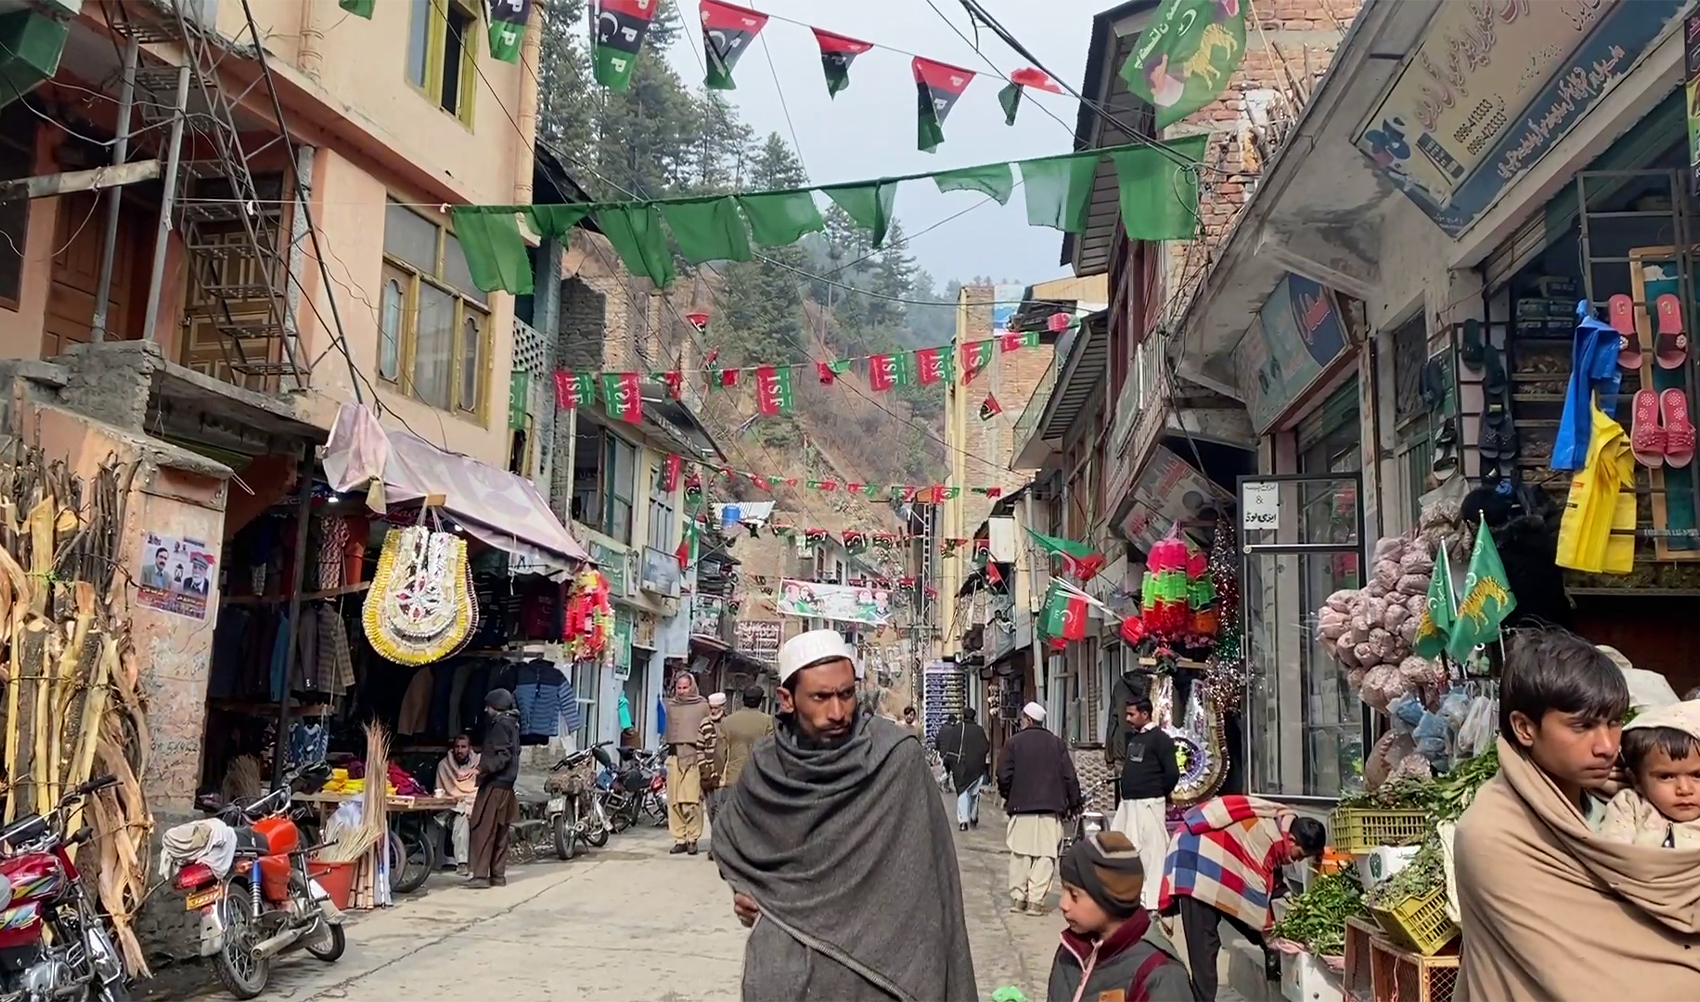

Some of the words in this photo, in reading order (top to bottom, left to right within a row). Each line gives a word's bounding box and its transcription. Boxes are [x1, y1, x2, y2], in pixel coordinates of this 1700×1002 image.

[502, 31, 516, 46] P
[621, 26, 638, 42] P
[611, 57, 627, 73] P
[1453, 98, 1494, 144] 0996-413333
[1467, 110, 1508, 157] 0996-423333
[882, 357, 898, 385] ISF
[929, 354, 946, 379] ISF
[565, 376, 583, 405] ISF
[766, 375, 785, 408] ISF
[1255, 495, 1265, 505] &
